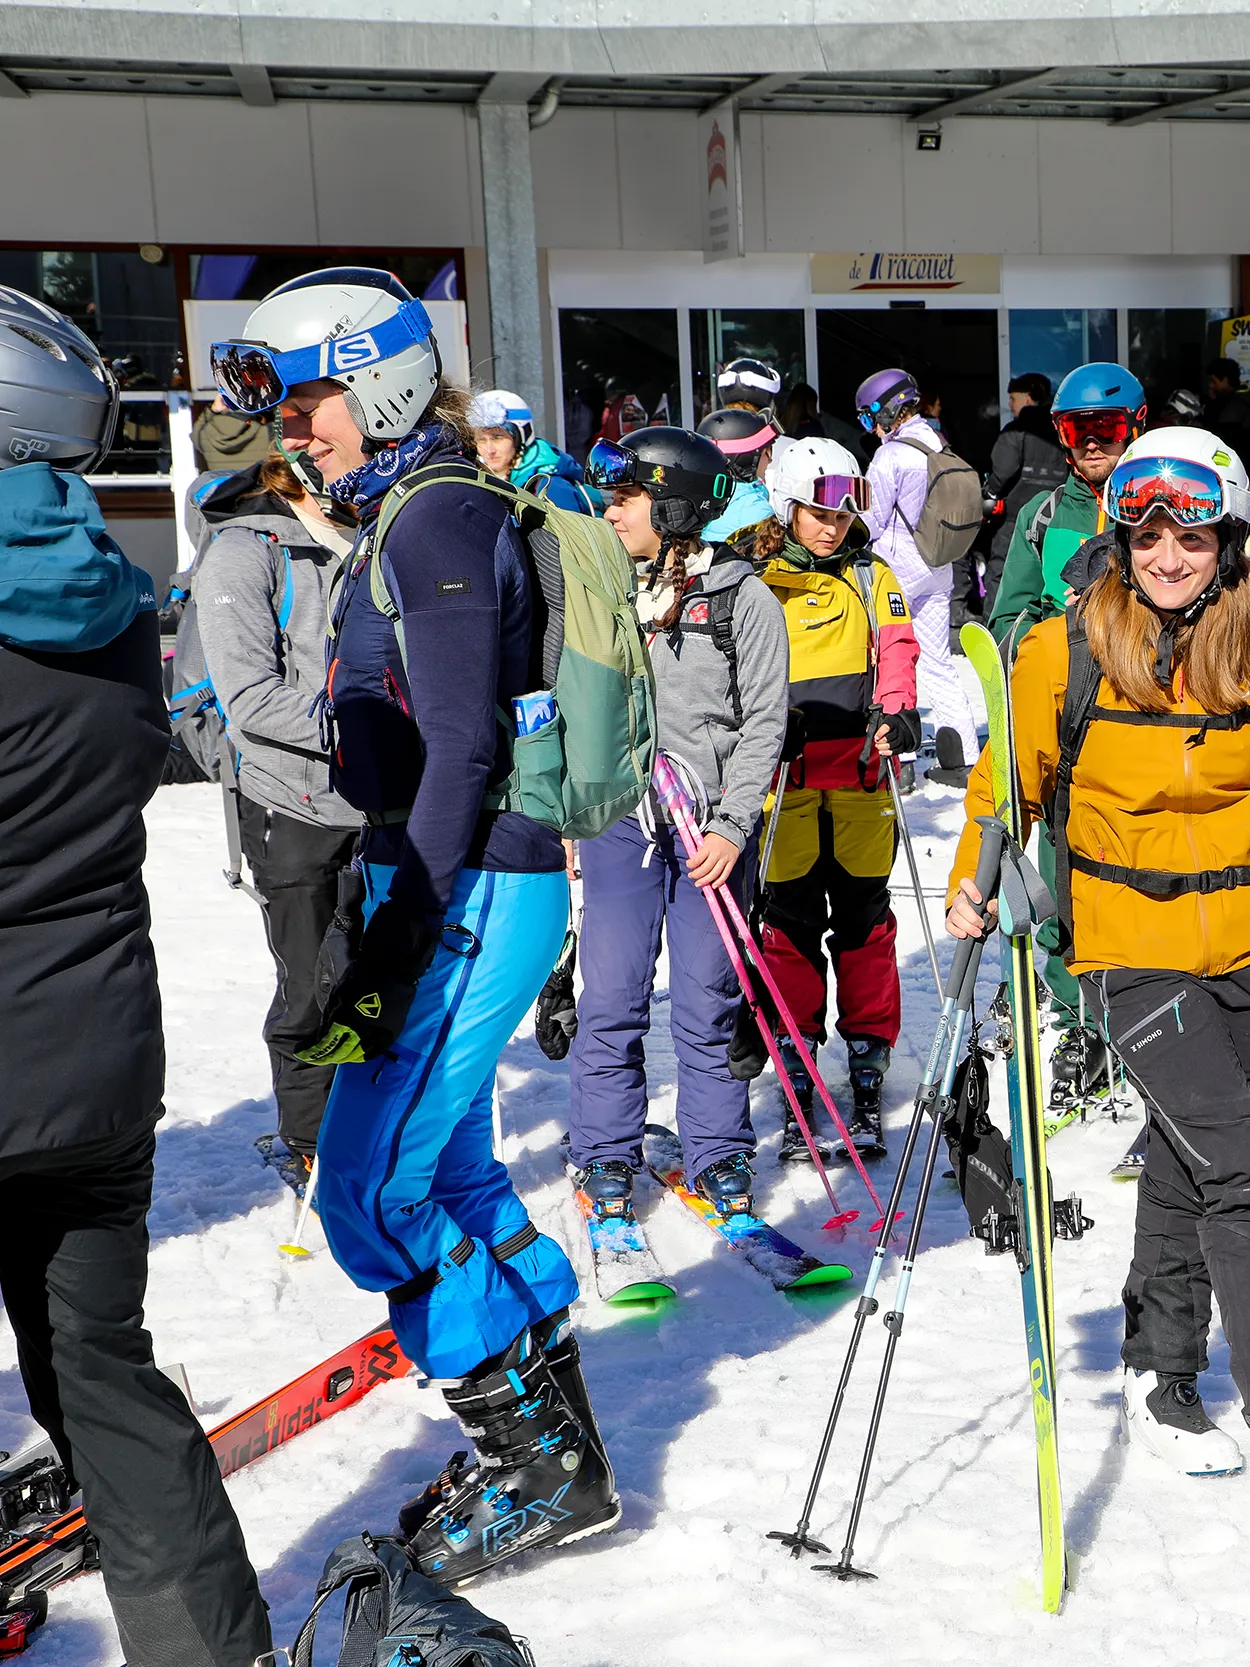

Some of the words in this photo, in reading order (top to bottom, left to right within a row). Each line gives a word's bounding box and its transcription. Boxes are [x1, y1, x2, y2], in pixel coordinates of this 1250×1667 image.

[848, 260, 861, 280] de
[1136, 1029, 1163, 1049] SIMOND
[217, 1396, 323, 1477] ACETIGER
[482, 1480, 574, 1559] RX
